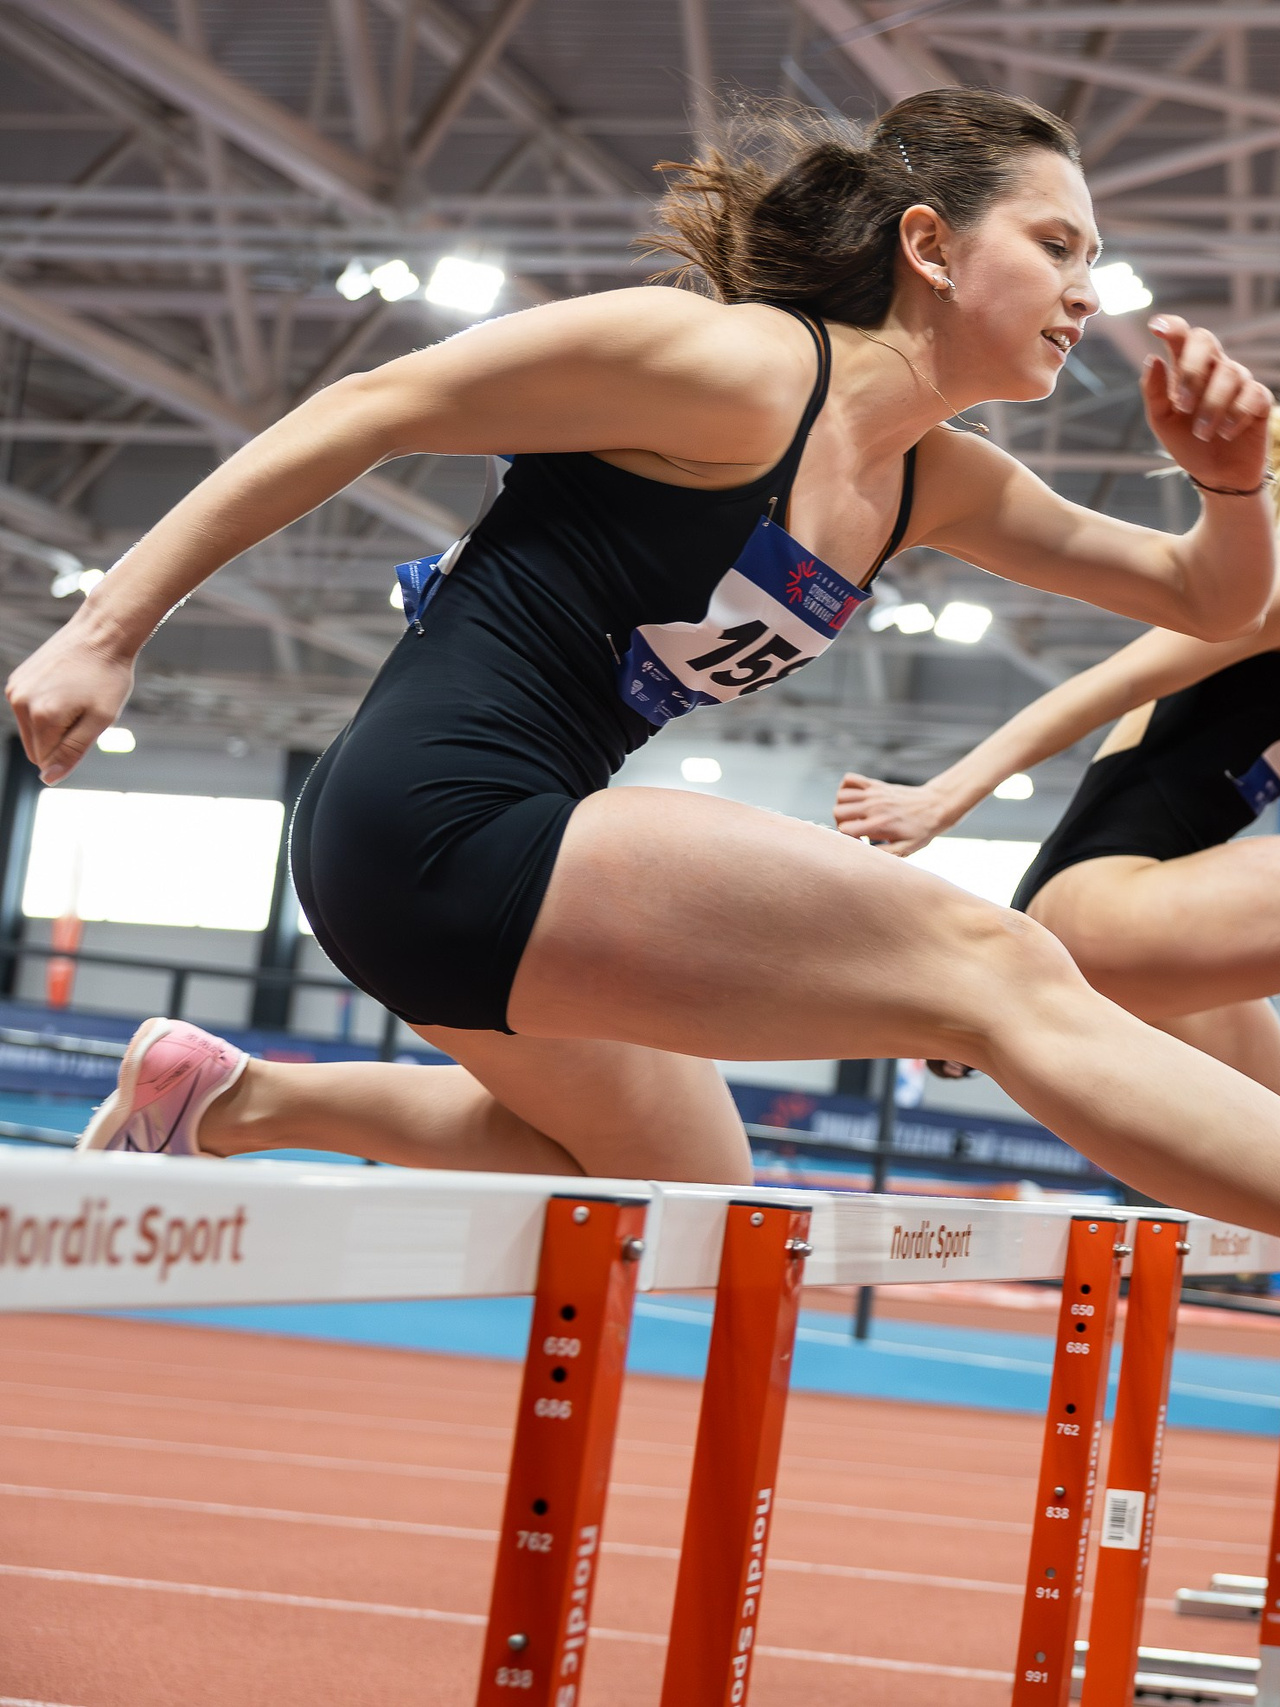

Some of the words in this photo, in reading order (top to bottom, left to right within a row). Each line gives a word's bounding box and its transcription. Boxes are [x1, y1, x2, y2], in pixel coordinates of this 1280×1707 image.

[135, 1205, 247, 1283] Sport
[936, 1224, 972, 1269] Sport
[1070, 1304, 1095, 1317] 650
[543, 1336, 581, 1358] 650
[1065, 1341, 1090, 1355] 686
[534, 1398, 572, 1420] 686
[1056, 1422, 1080, 1437] 762
[1045, 1506, 1070, 1520] 838
[516, 1530, 553, 1553] 762
[1035, 1586, 1060, 1600] 914
[495, 1667, 533, 1689] 838
[1025, 1670, 1048, 1684] 991
